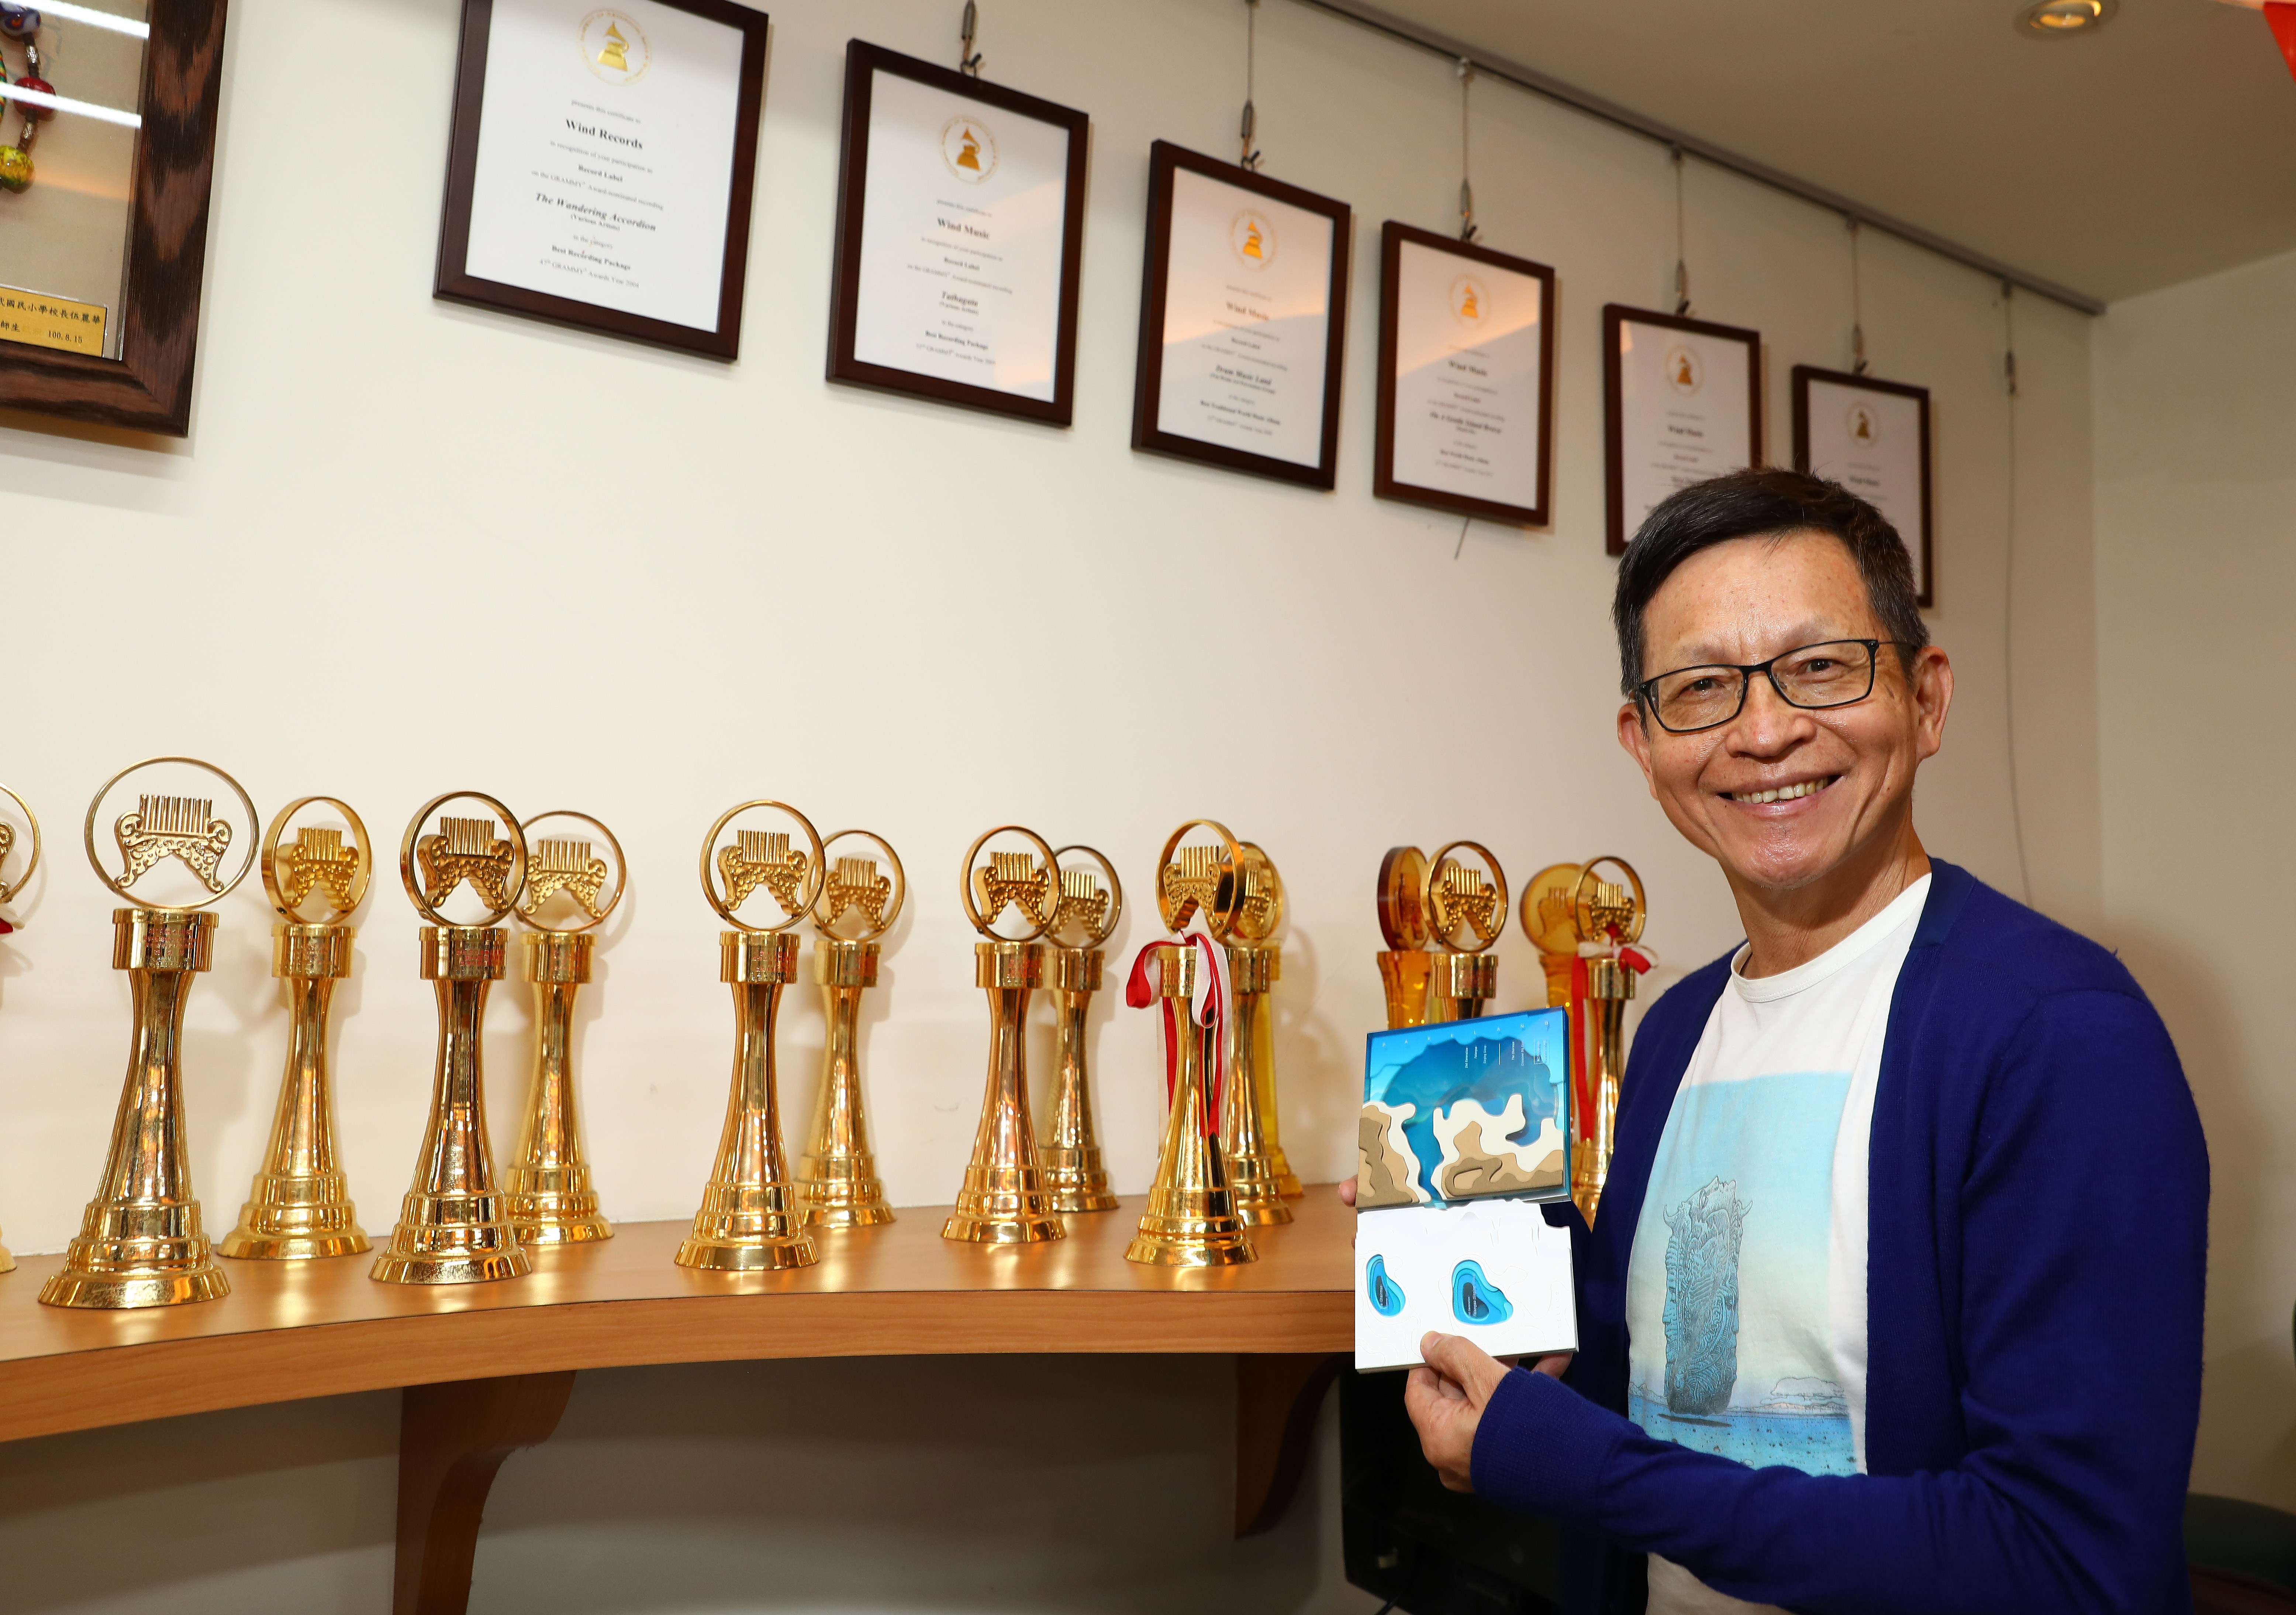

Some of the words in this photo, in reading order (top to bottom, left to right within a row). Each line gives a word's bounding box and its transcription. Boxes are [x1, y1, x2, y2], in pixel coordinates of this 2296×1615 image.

[566, 118, 595, 136] Wind
[600, 129, 643, 149] Records
[578, 164, 602, 175] Record
[604, 171, 623, 182] Label
[536, 193, 553, 204] The
[557, 198, 607, 220] Wandering
[610, 213, 656, 232] Accordion
[937, 217, 961, 232] Wind
[965, 224, 990, 240] Music
[552, 245, 566, 254] Best
[569, 249, 602, 264] Recording
[604, 258, 631, 271] Package
